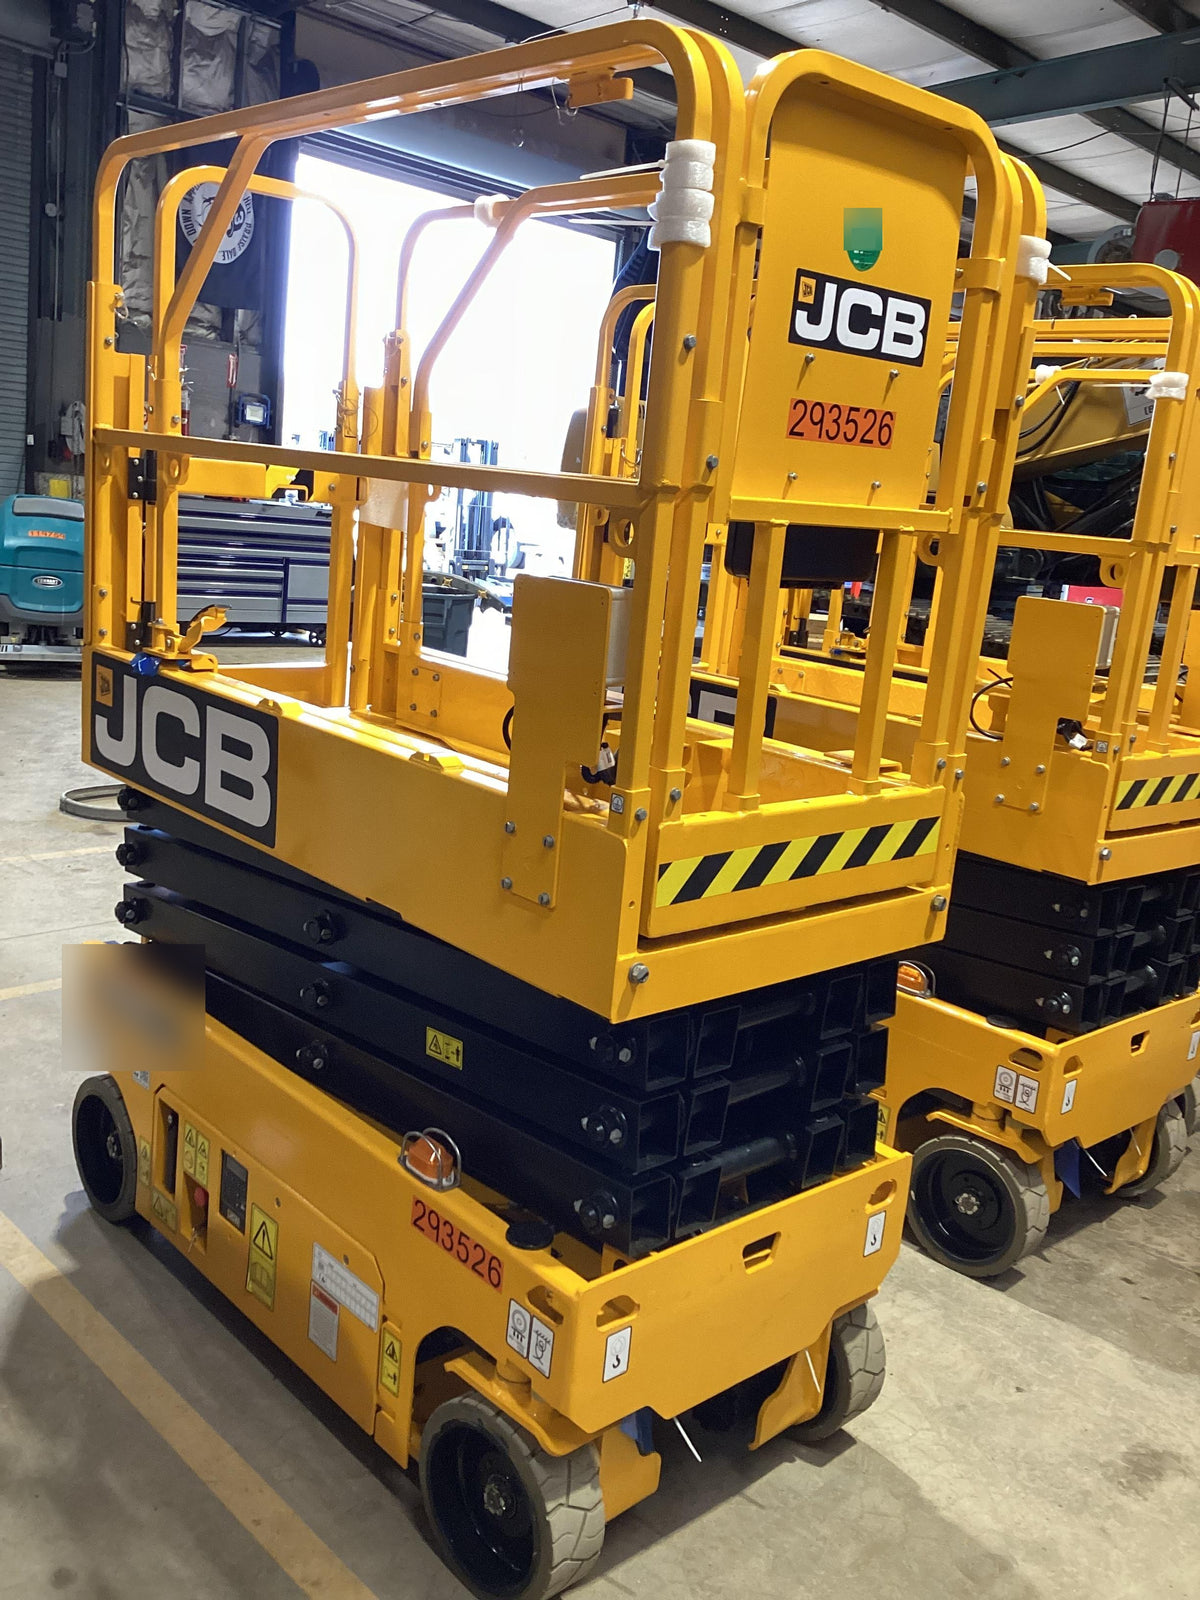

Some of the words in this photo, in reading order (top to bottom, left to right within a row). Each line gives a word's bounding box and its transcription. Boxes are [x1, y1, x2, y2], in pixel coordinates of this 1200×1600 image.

[181, 208, 197, 237] DOWN
[794, 282, 926, 359] JCB
[788, 399, 894, 446] 293526
[95, 674, 271, 828] JCB
[413, 1199, 502, 1288] 293526
